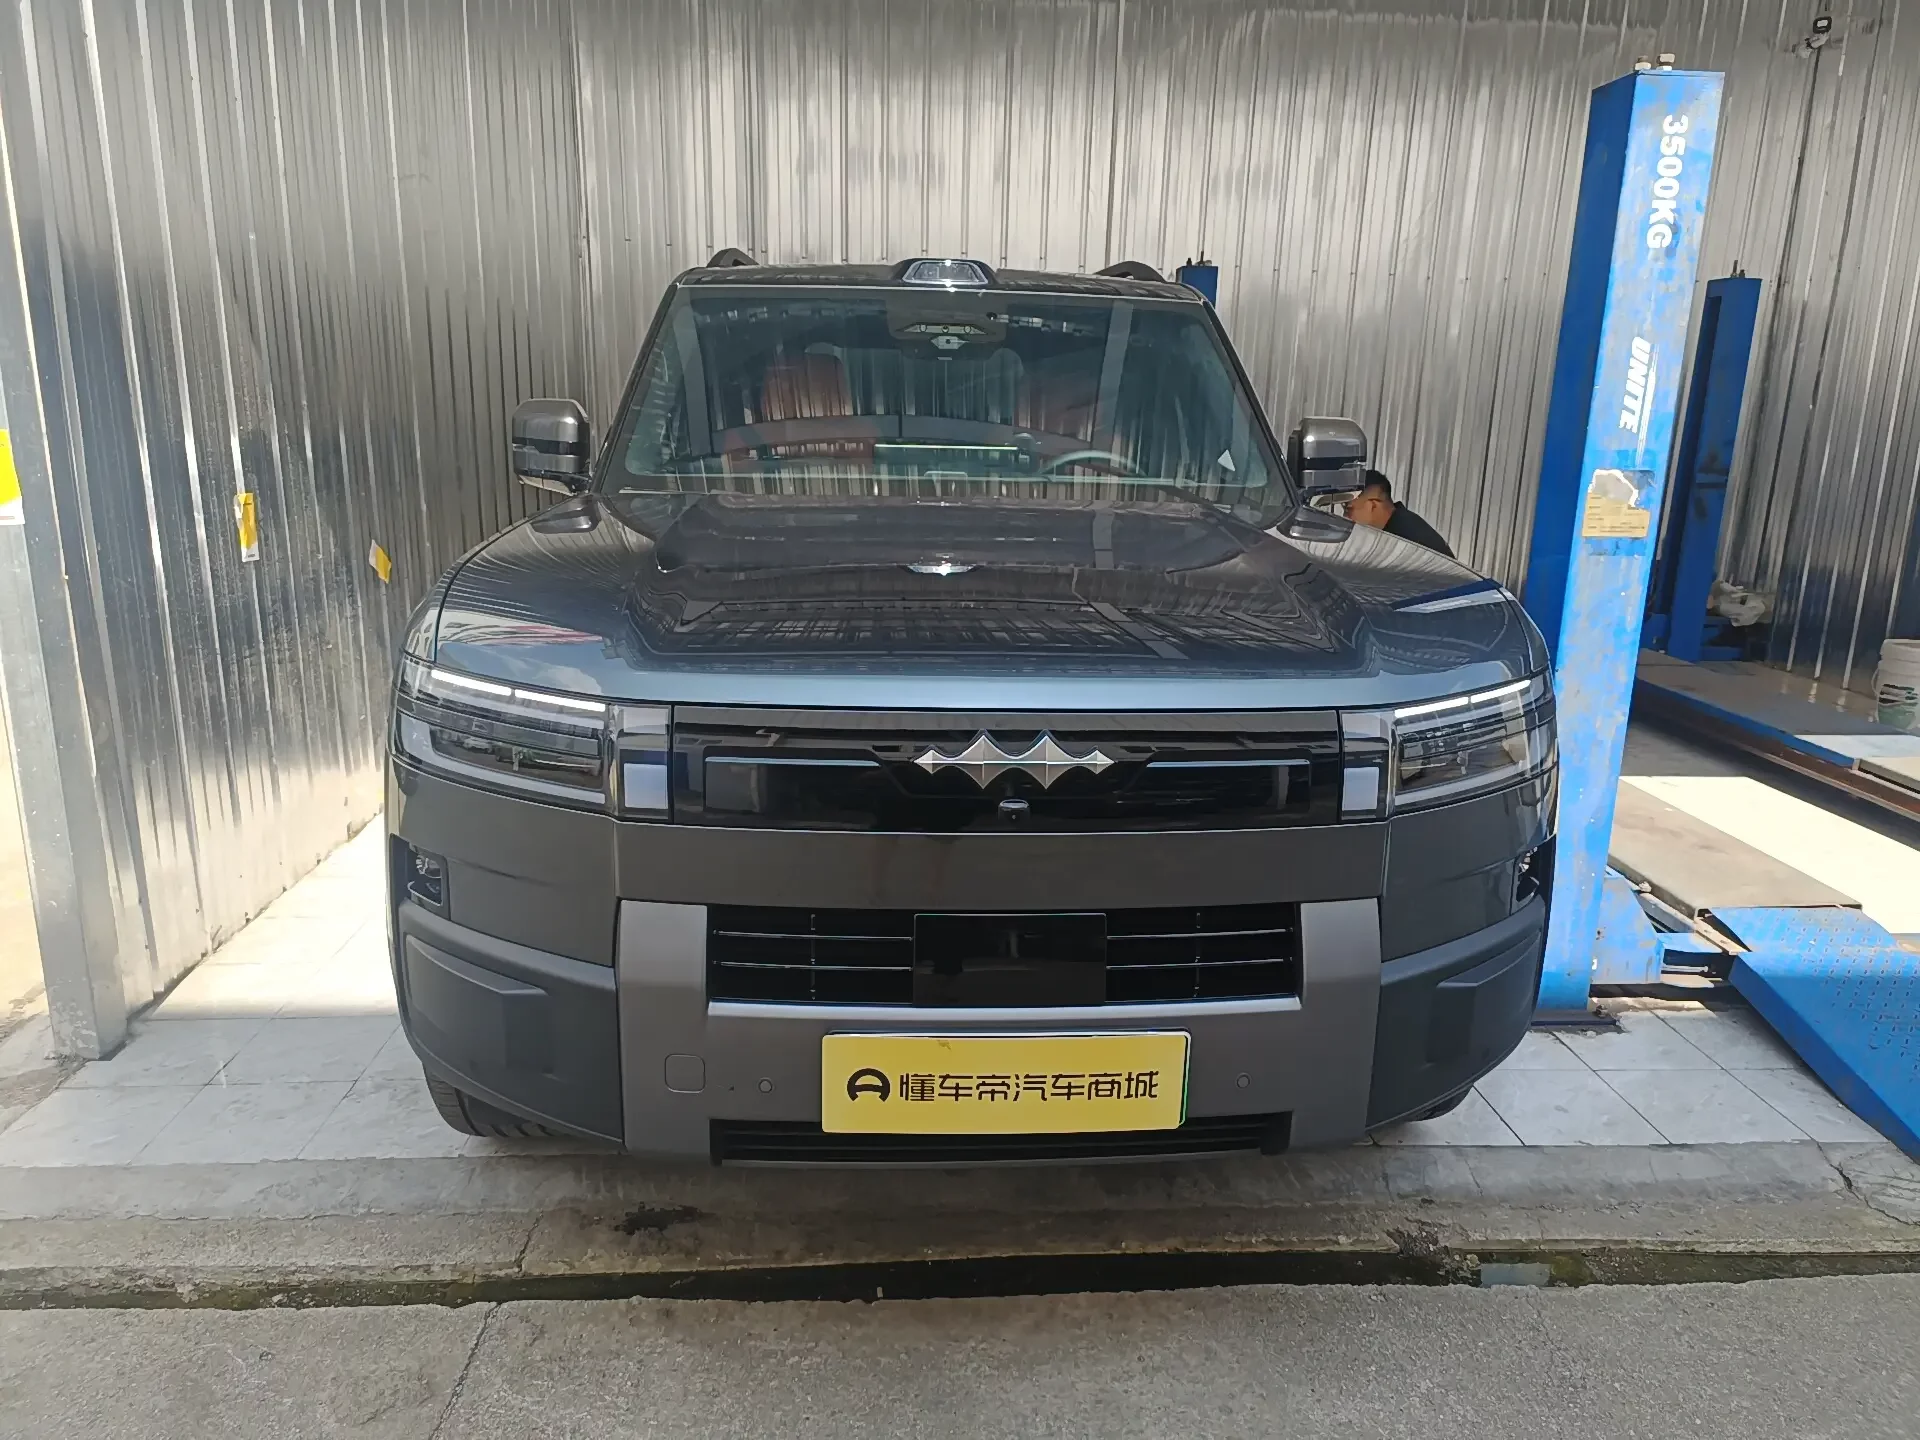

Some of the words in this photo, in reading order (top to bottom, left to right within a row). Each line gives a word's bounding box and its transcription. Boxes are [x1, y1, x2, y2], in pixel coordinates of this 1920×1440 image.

[1646, 114, 1689, 249] 3500KG
[1618, 336, 1651, 434] UNITE
[899, 1070, 1160, 1102] 懂车帝汽车商城
